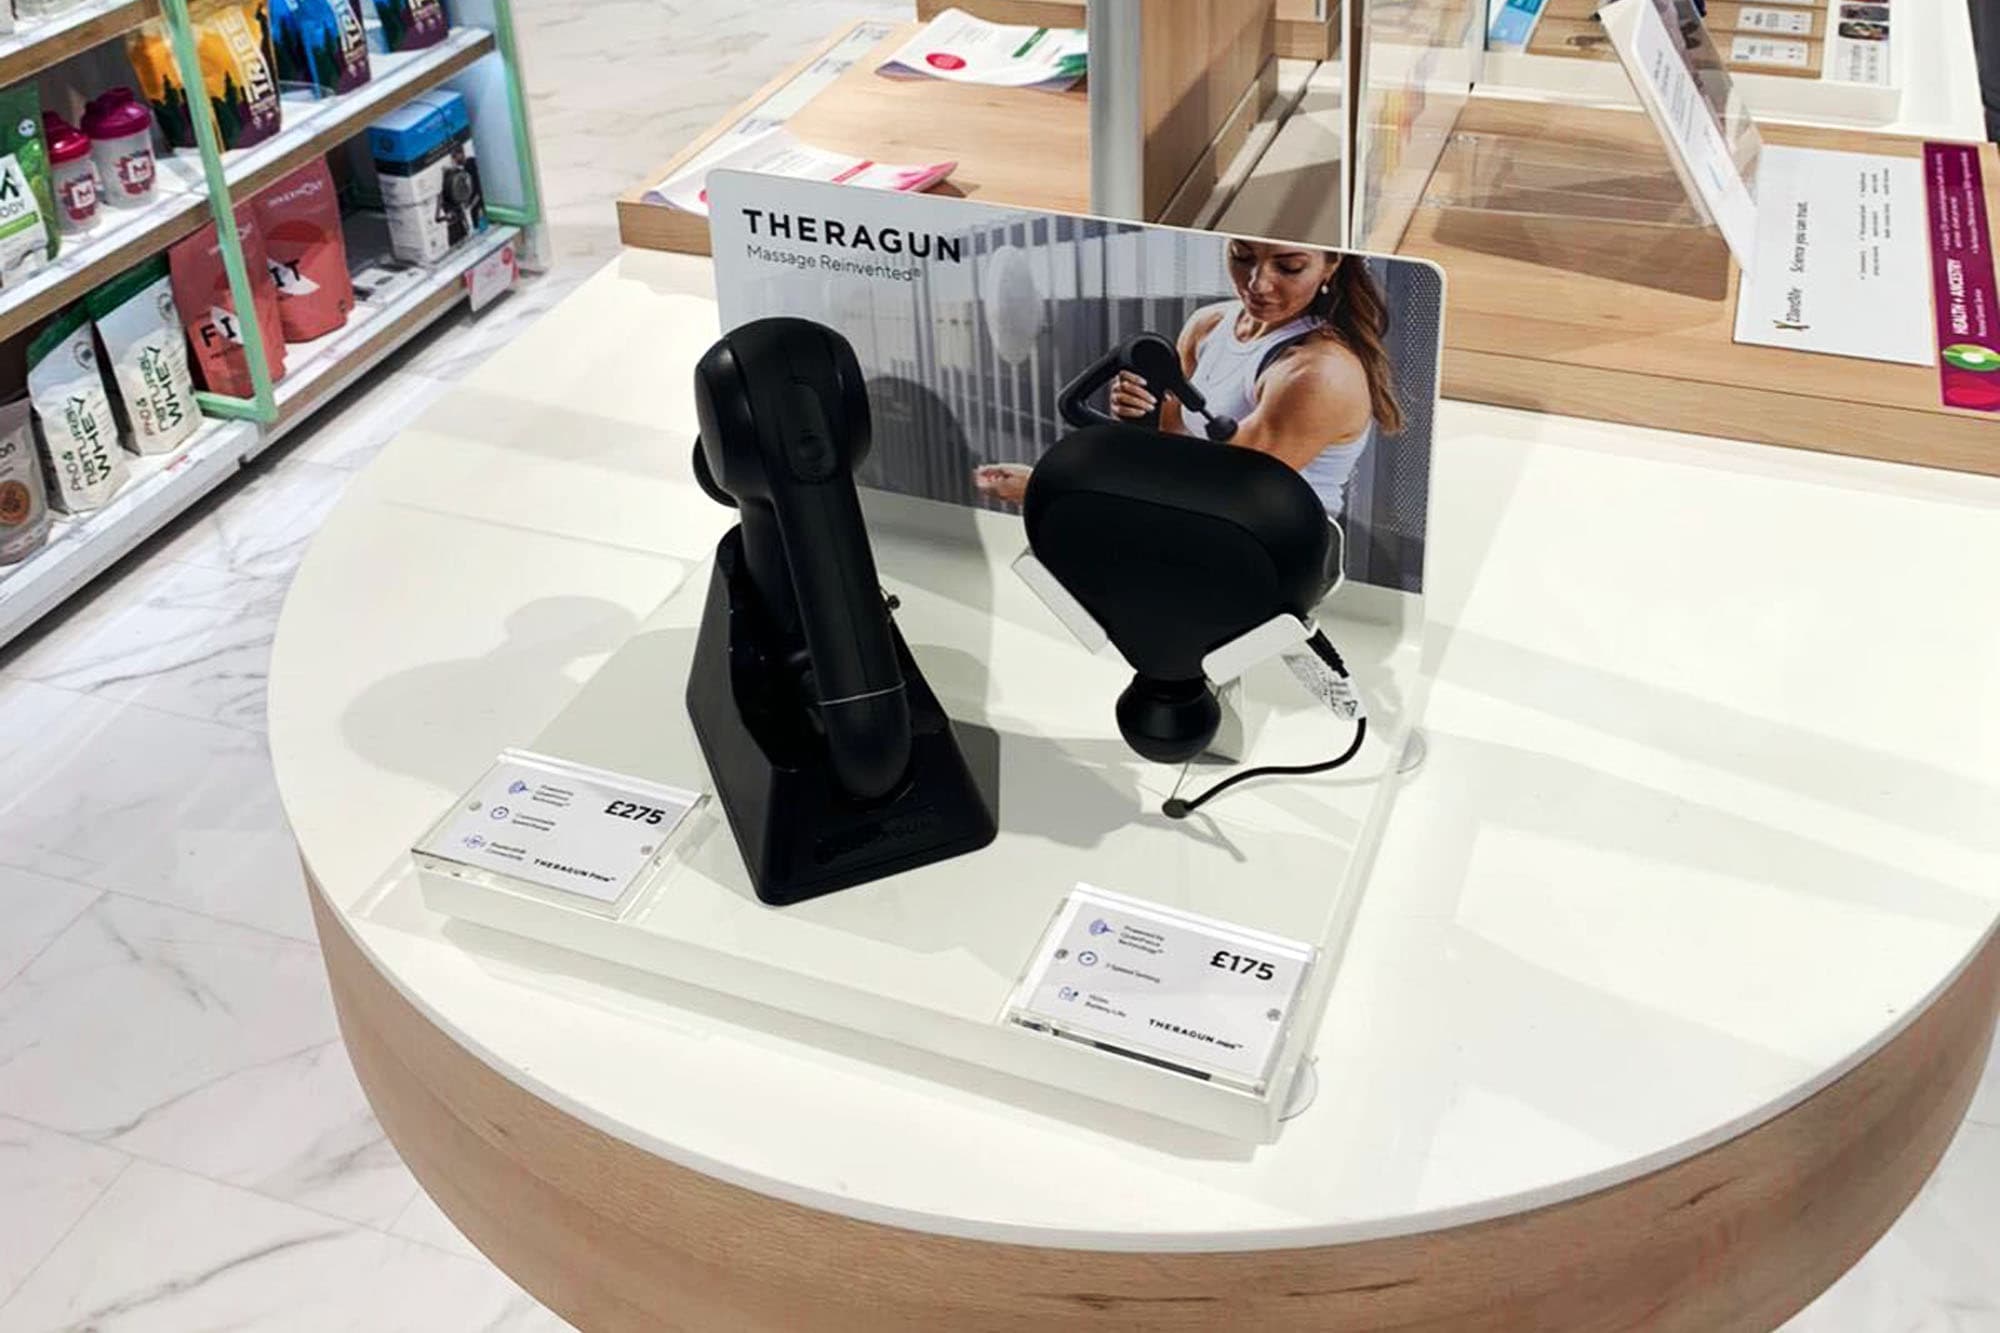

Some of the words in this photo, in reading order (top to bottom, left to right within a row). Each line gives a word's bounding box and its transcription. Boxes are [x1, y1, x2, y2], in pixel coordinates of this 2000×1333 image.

[742, 209, 962, 264] THERAGUN
[747, 245, 817, 270] Massage
[200, 316, 237, 347] FI
[146, 346, 183, 427] WHEY
[71, 396, 112, 480] WHEY
[604, 800, 665, 825] £275
[1209, 949, 1276, 981] £175
[1149, 1018, 1214, 1042] THERAGUN
